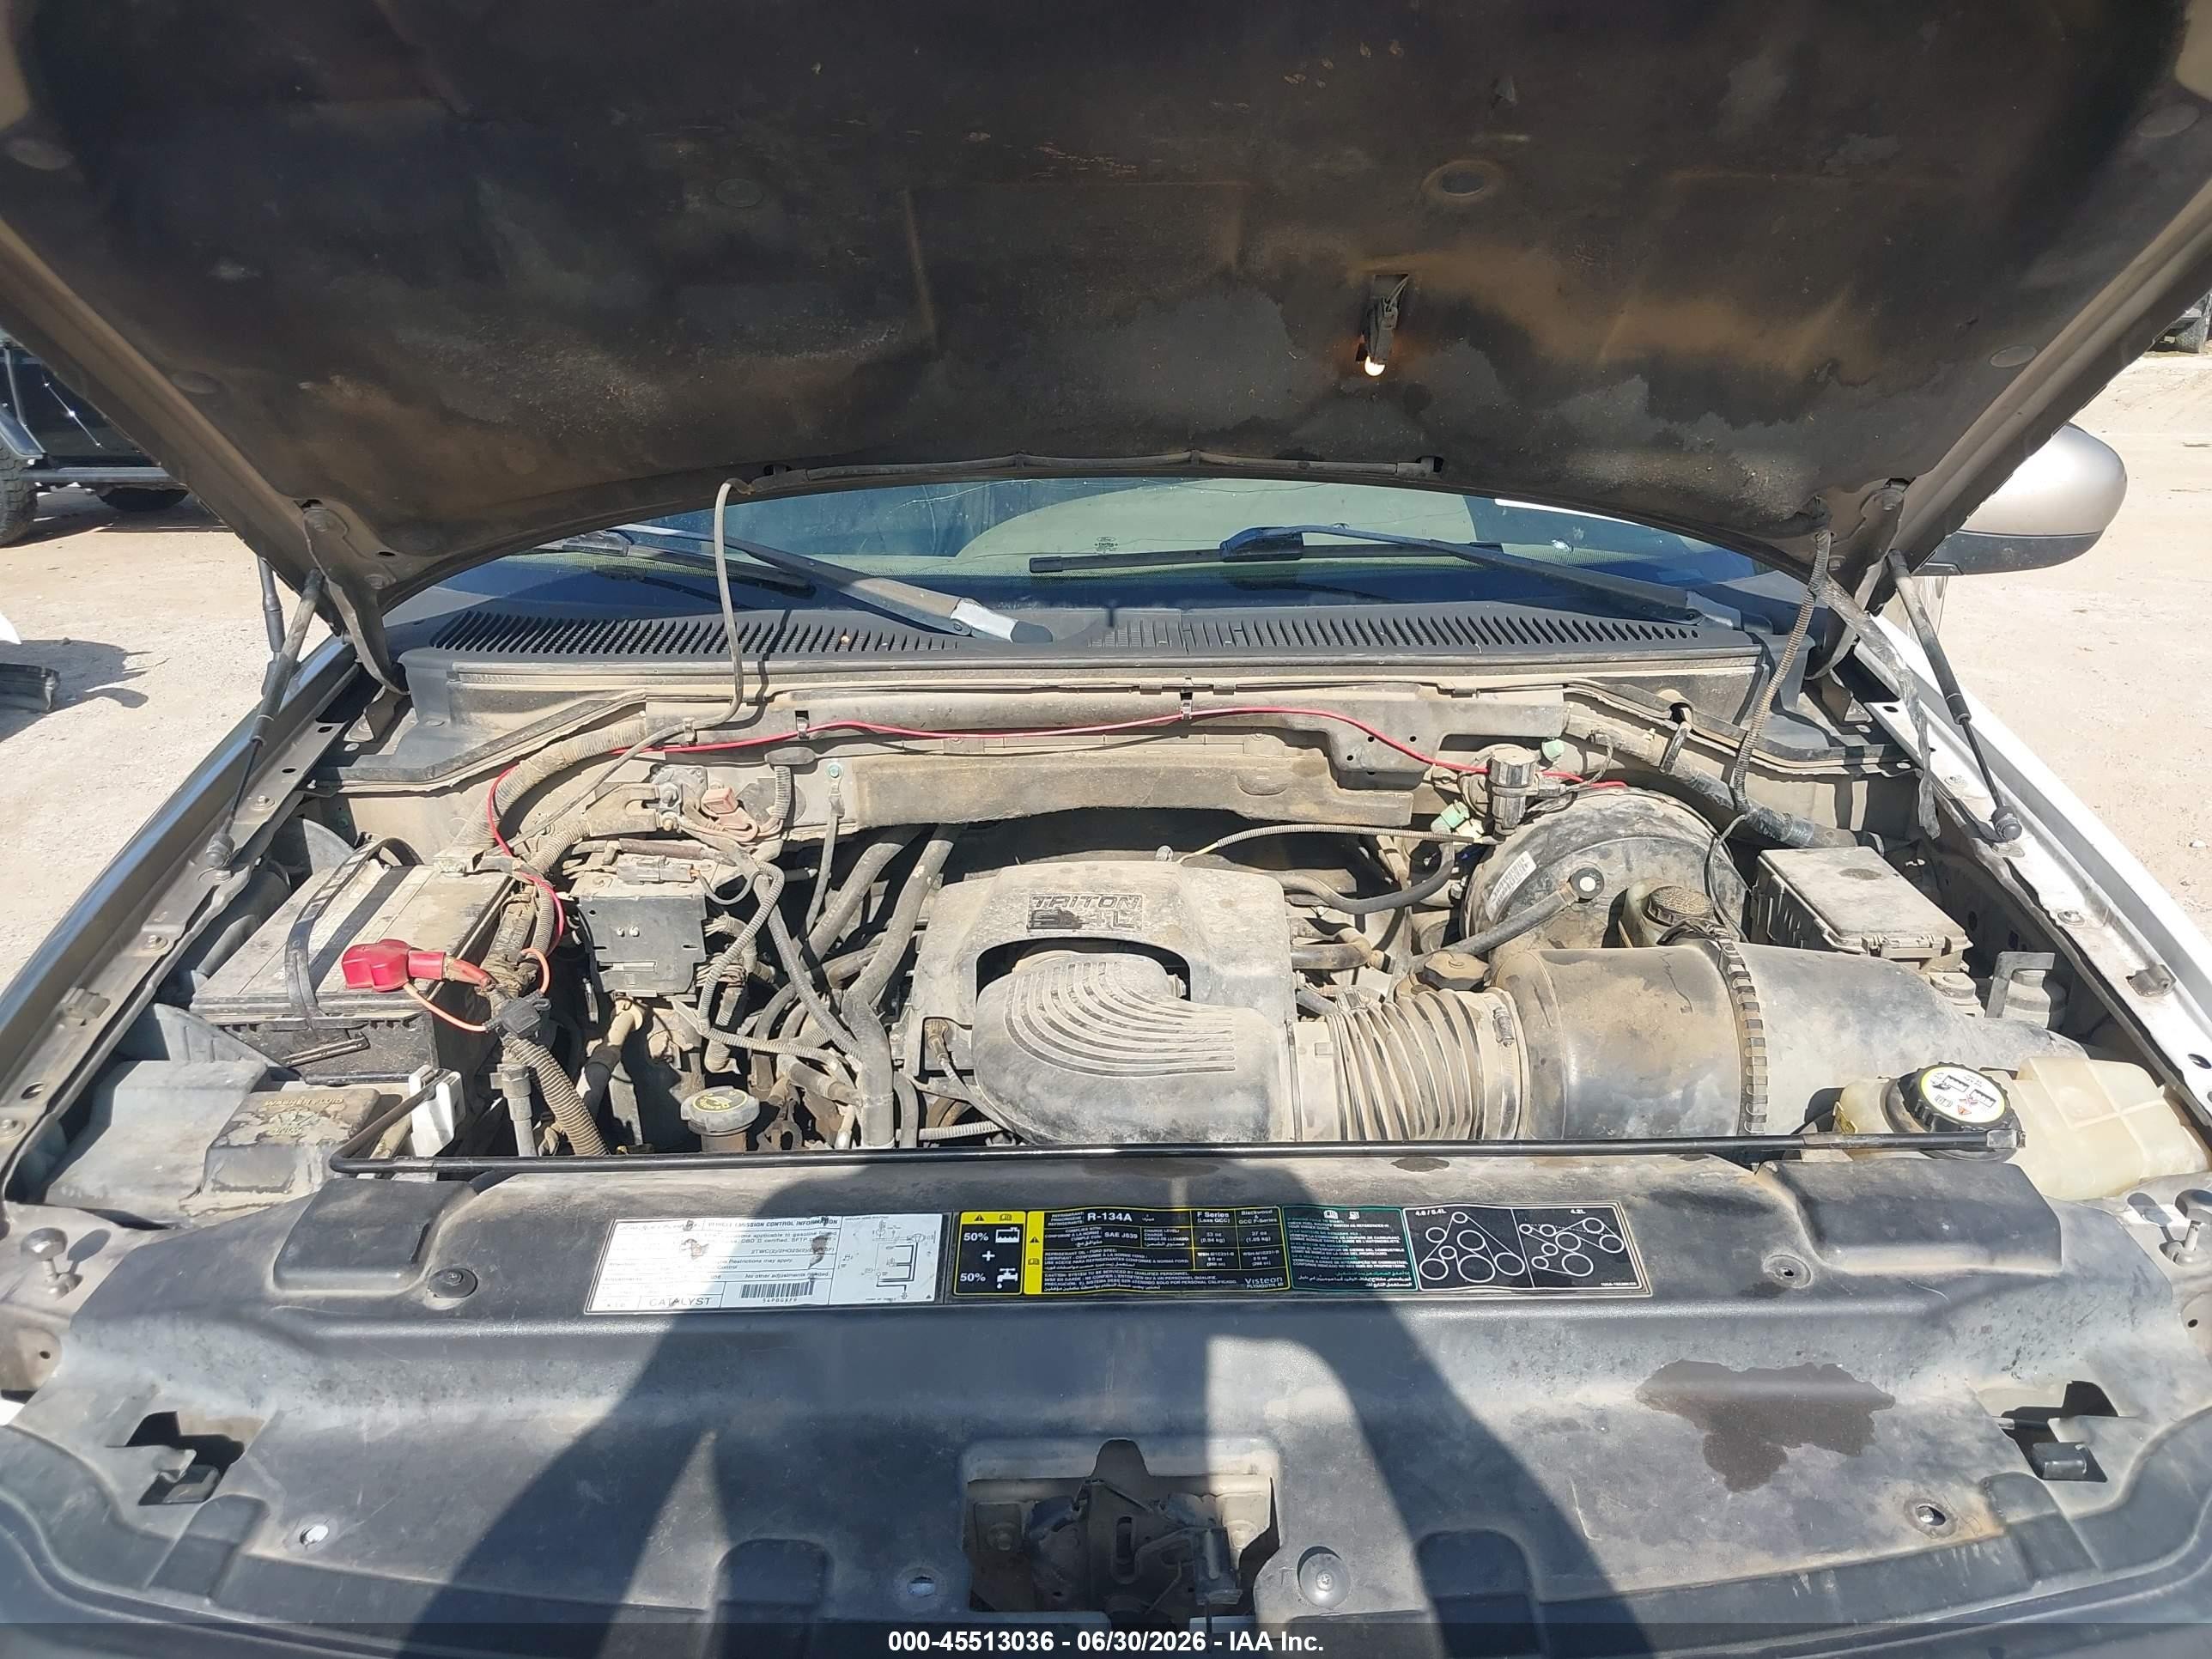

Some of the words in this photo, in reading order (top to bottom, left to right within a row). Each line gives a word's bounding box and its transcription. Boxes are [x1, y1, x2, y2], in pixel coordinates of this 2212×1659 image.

[1032, 896, 1139, 909] TRITON
[1087, 1212, 1133, 1222] R-134A
[960, 1273, 986, 1282] 50%
